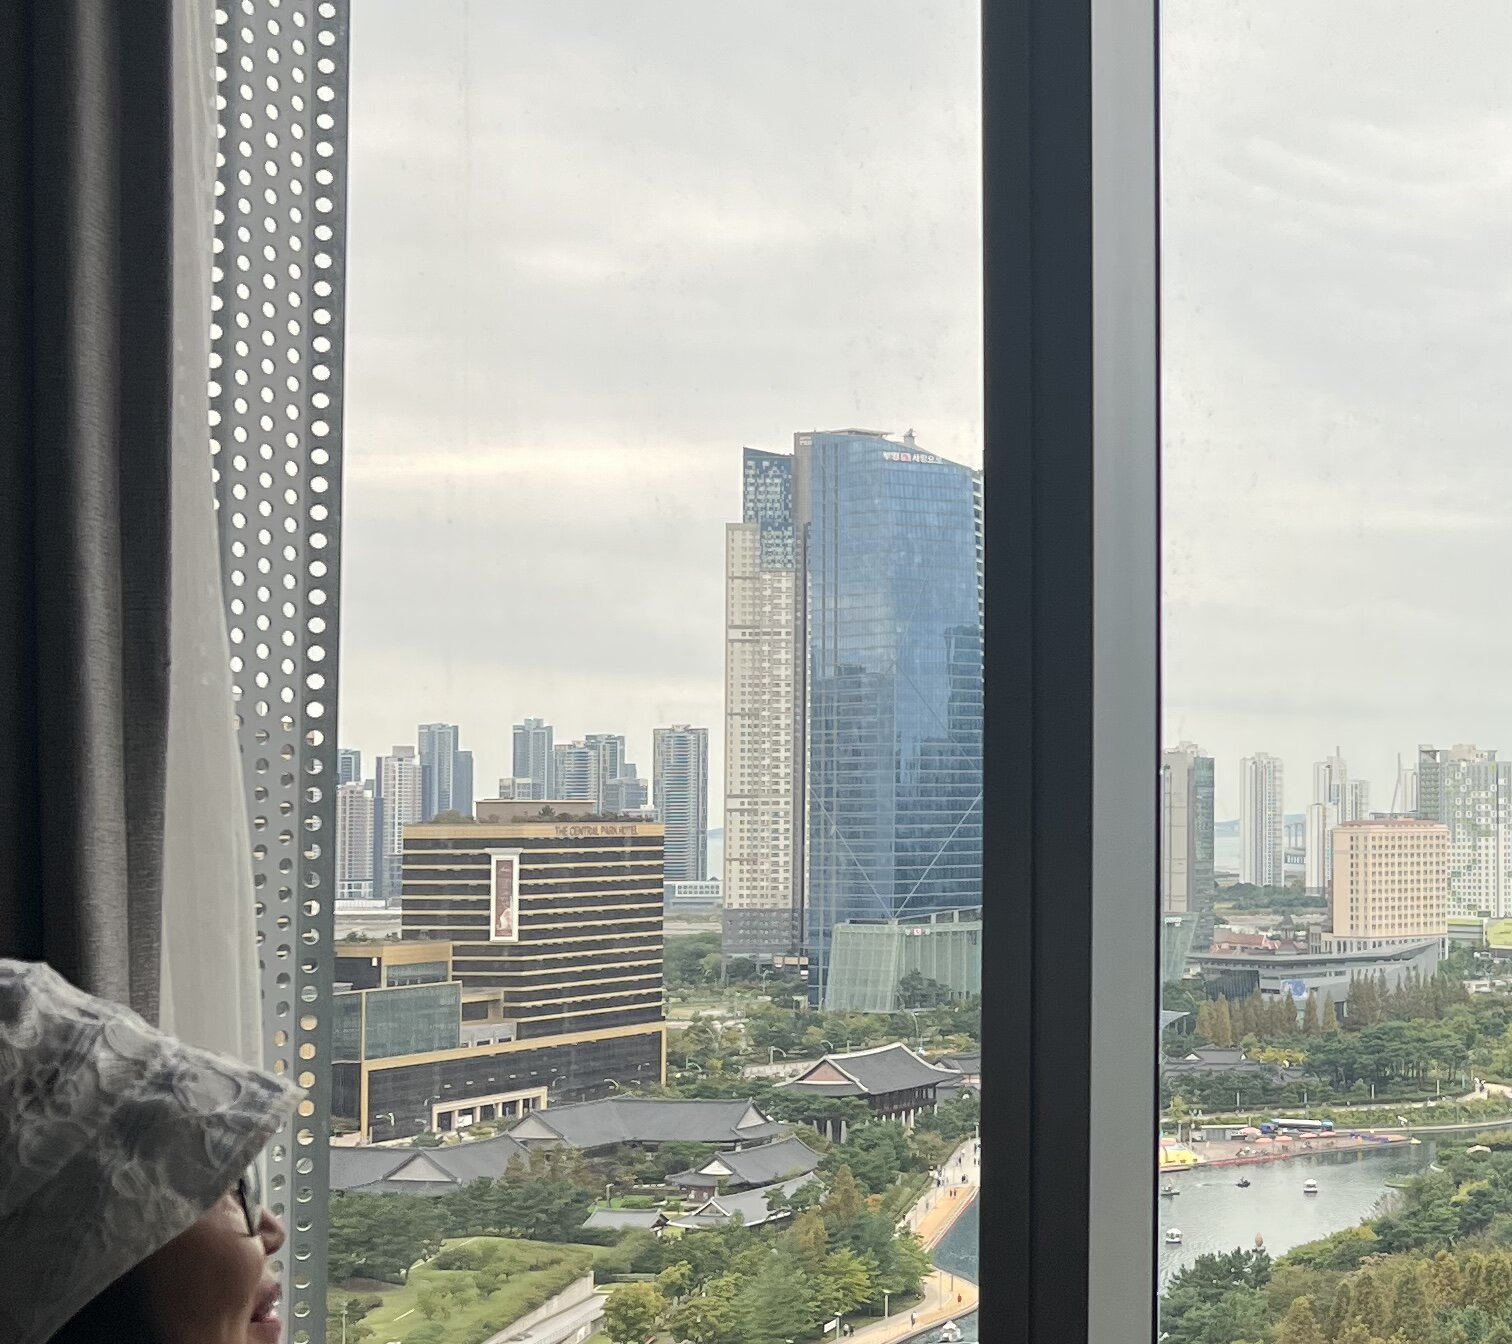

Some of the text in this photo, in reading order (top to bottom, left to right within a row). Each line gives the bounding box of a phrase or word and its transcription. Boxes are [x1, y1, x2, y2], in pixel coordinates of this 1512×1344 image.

[555, 825, 639, 836] THE CENTRAL PARK HOTEL
